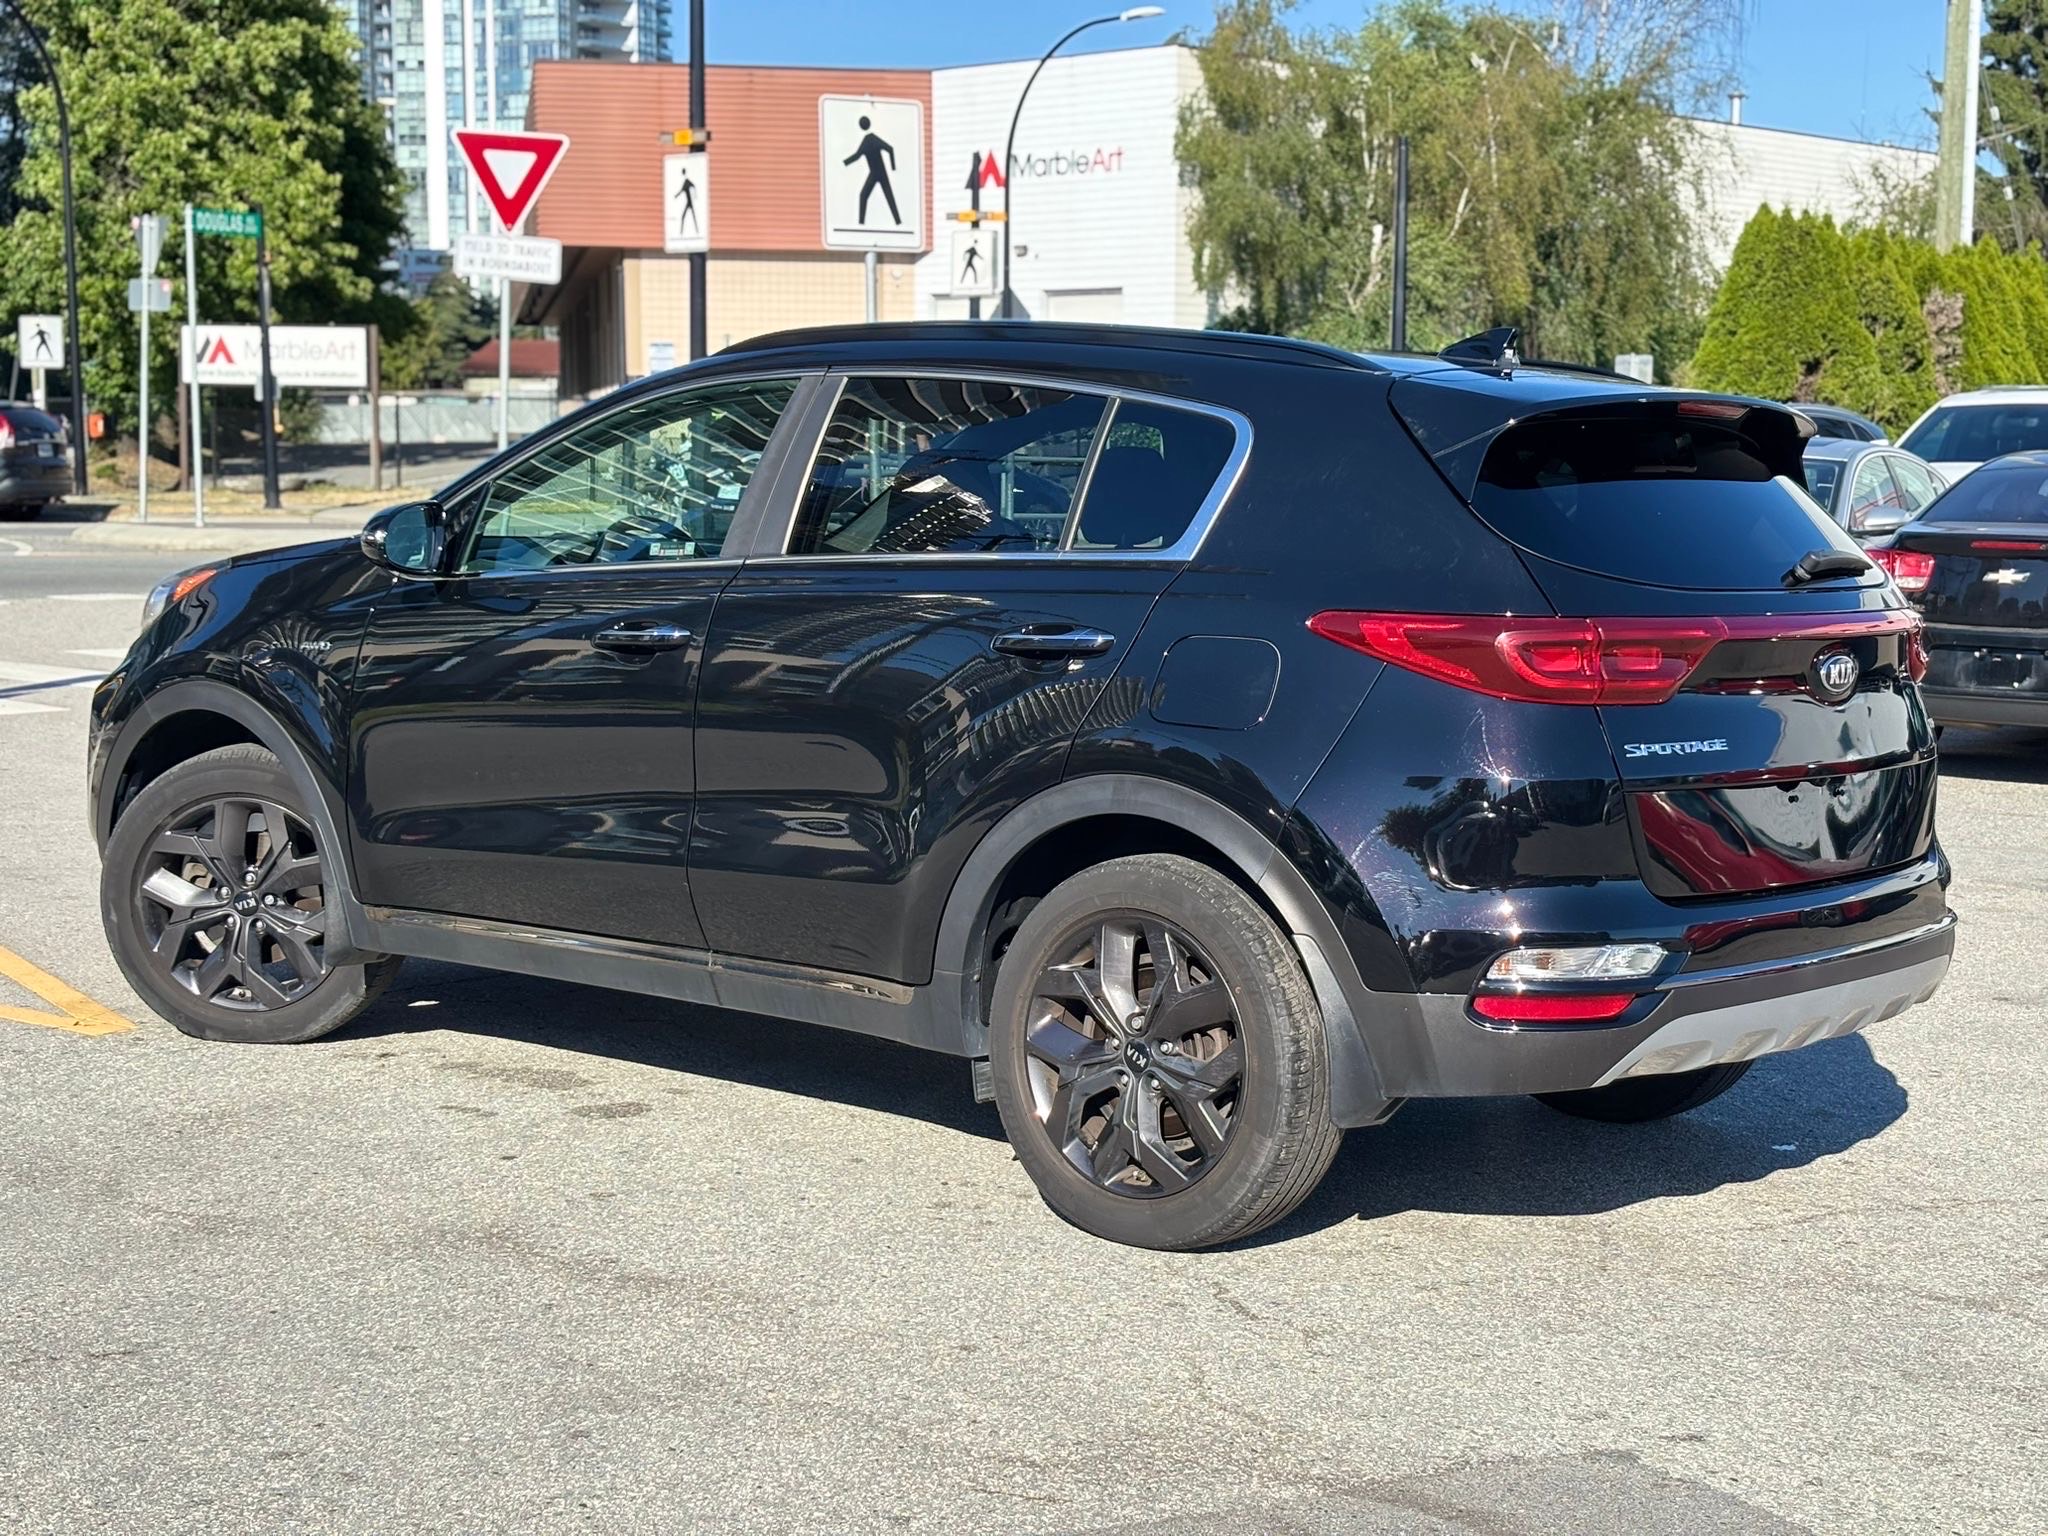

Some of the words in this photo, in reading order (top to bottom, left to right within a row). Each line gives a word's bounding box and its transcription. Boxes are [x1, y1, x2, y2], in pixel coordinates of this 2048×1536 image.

[1010, 147, 1123, 178] MarbleArt
[195, 211, 244, 233] DOUGLAS
[496, 242, 511, 255] TO
[1829, 663, 1854, 685] KIA
[1623, 738, 1729, 758] SPORTAGE
[234, 897, 257, 911] KIA
[1126, 1043, 1147, 1068] KIA
